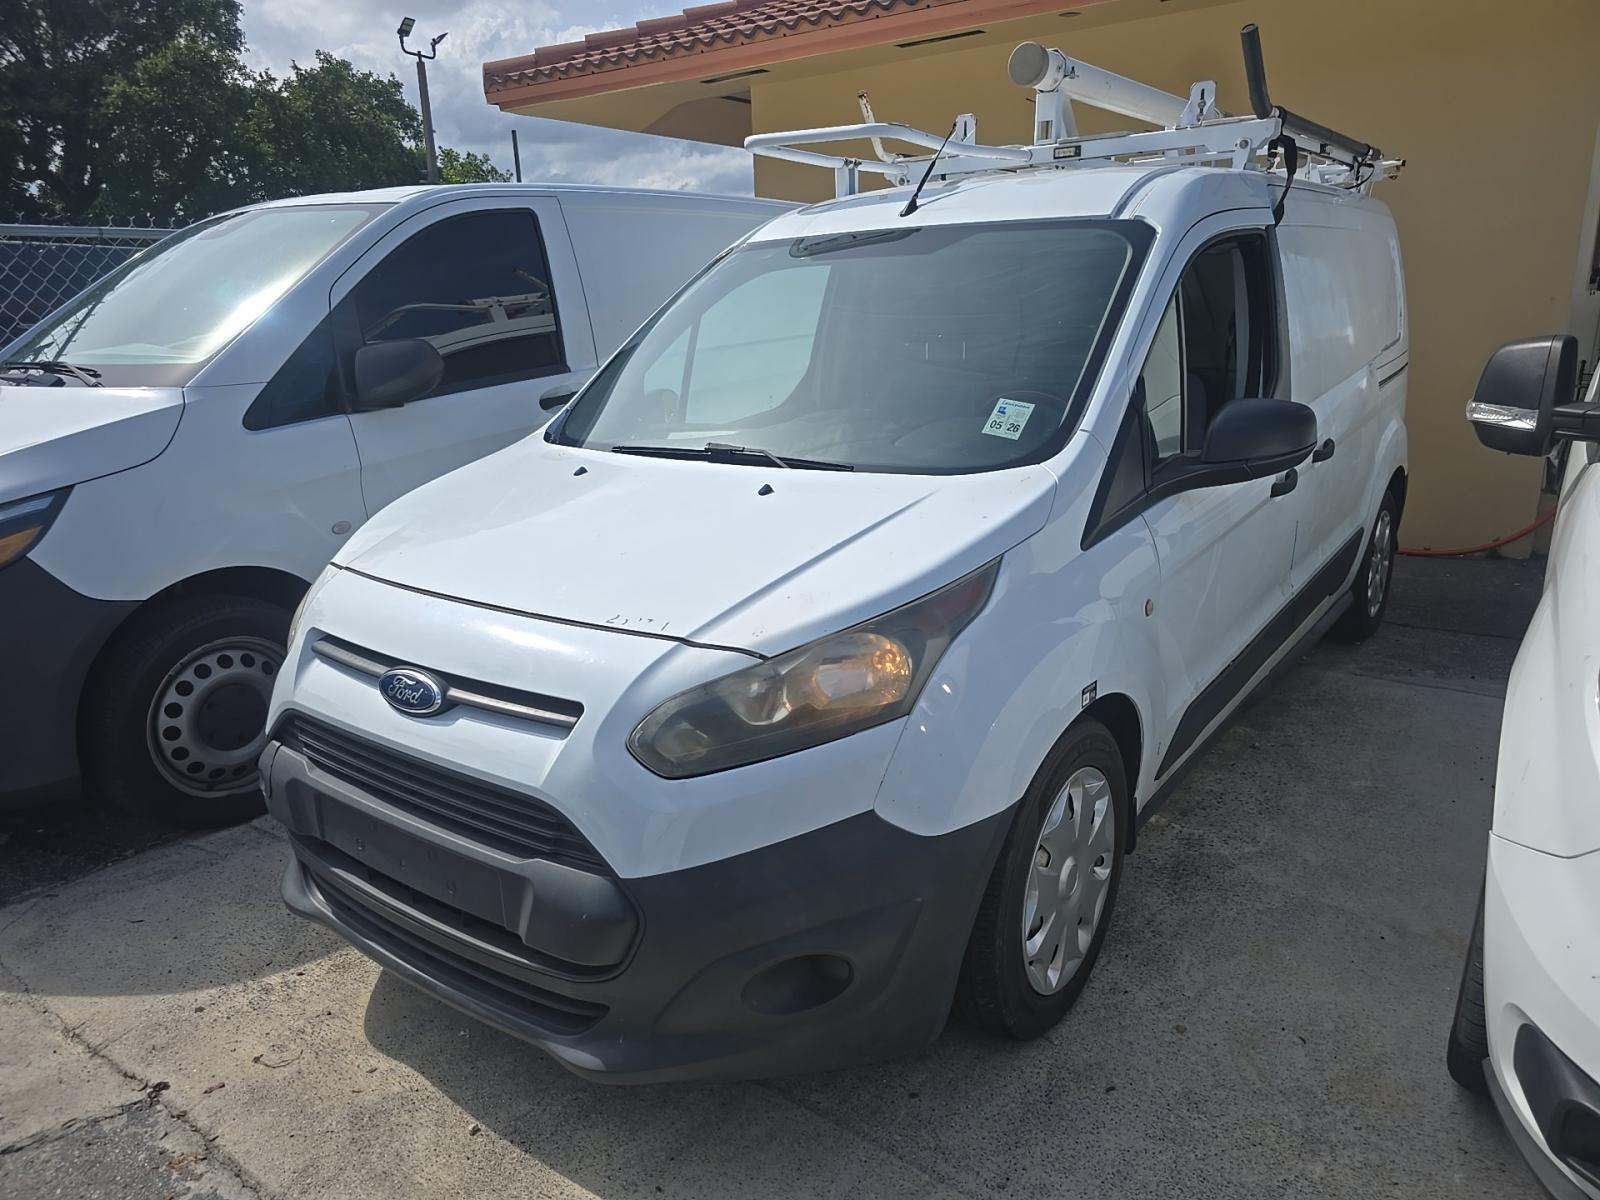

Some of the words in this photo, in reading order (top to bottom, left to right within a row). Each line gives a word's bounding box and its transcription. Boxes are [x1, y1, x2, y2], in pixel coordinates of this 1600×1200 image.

[989, 419, 1003, 430] 05
[1006, 422, 1021, 433] 26
[388, 675, 424, 704] Ford
